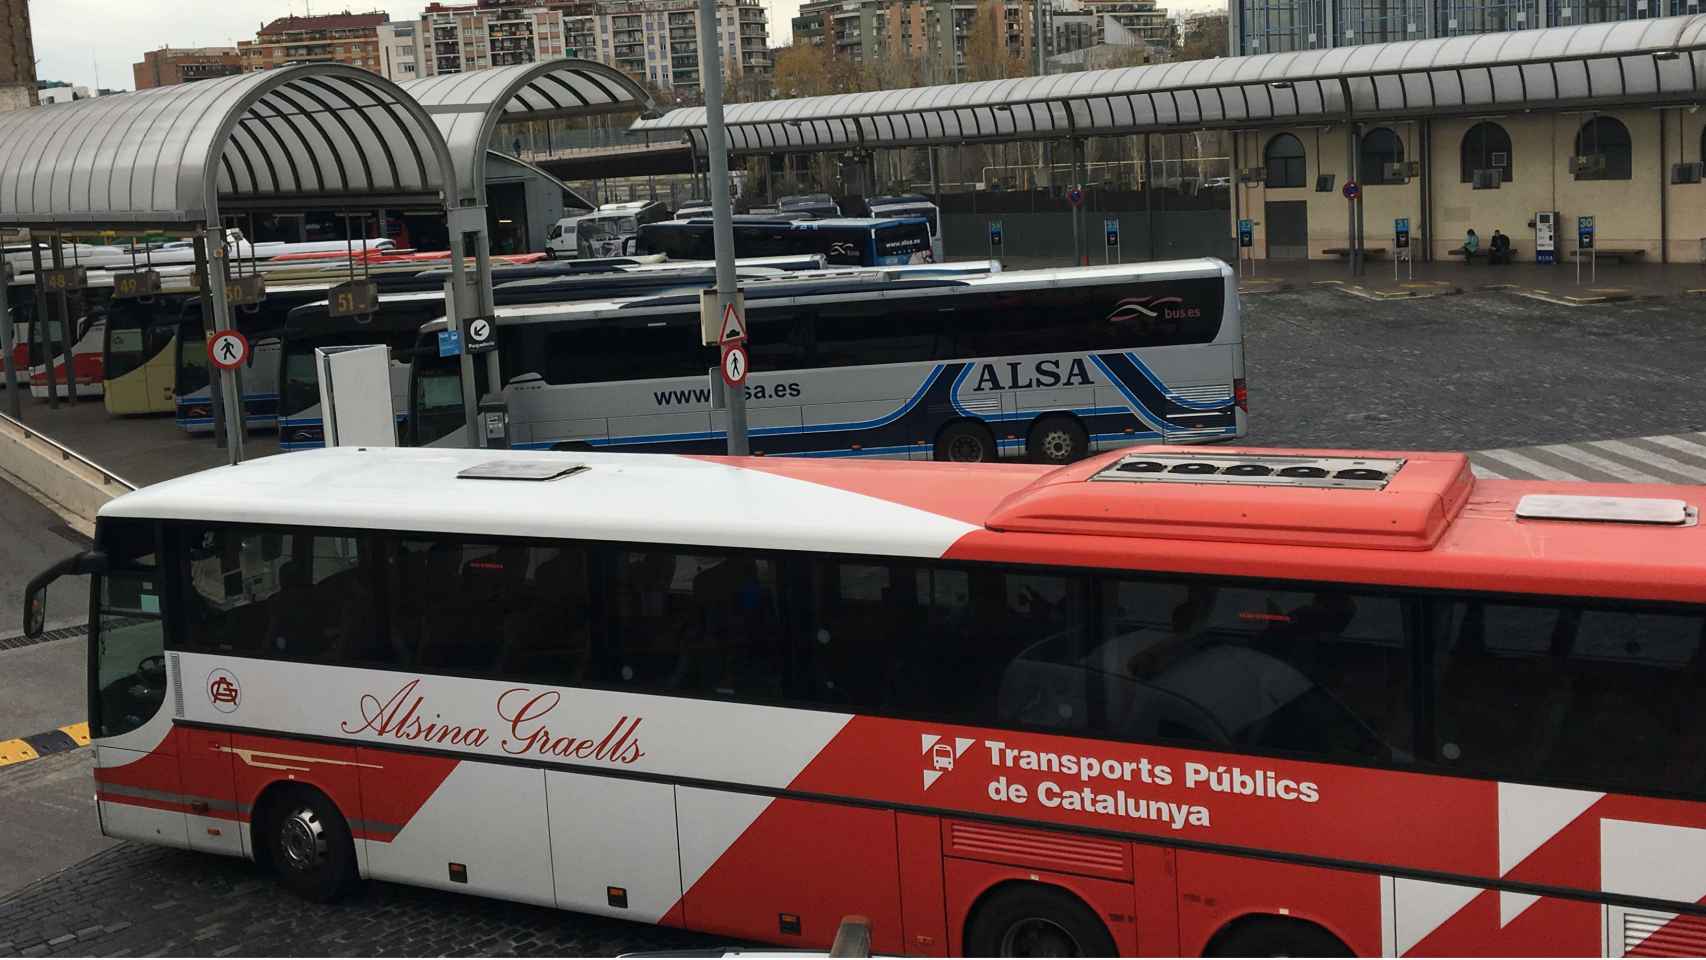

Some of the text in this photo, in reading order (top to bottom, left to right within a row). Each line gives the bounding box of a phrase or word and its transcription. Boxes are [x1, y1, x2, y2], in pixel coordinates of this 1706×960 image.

[1580, 218, 1593, 227] 30
[120, 279, 136, 293] 49
[337, 294, 353, 312] 51
[973, 358, 1094, 392] ALSA
[341, 679, 646, 764] Alsina Graells
[985, 740, 1320, 804] Transports Públics
[988, 776, 1211, 831] de Catalunya
